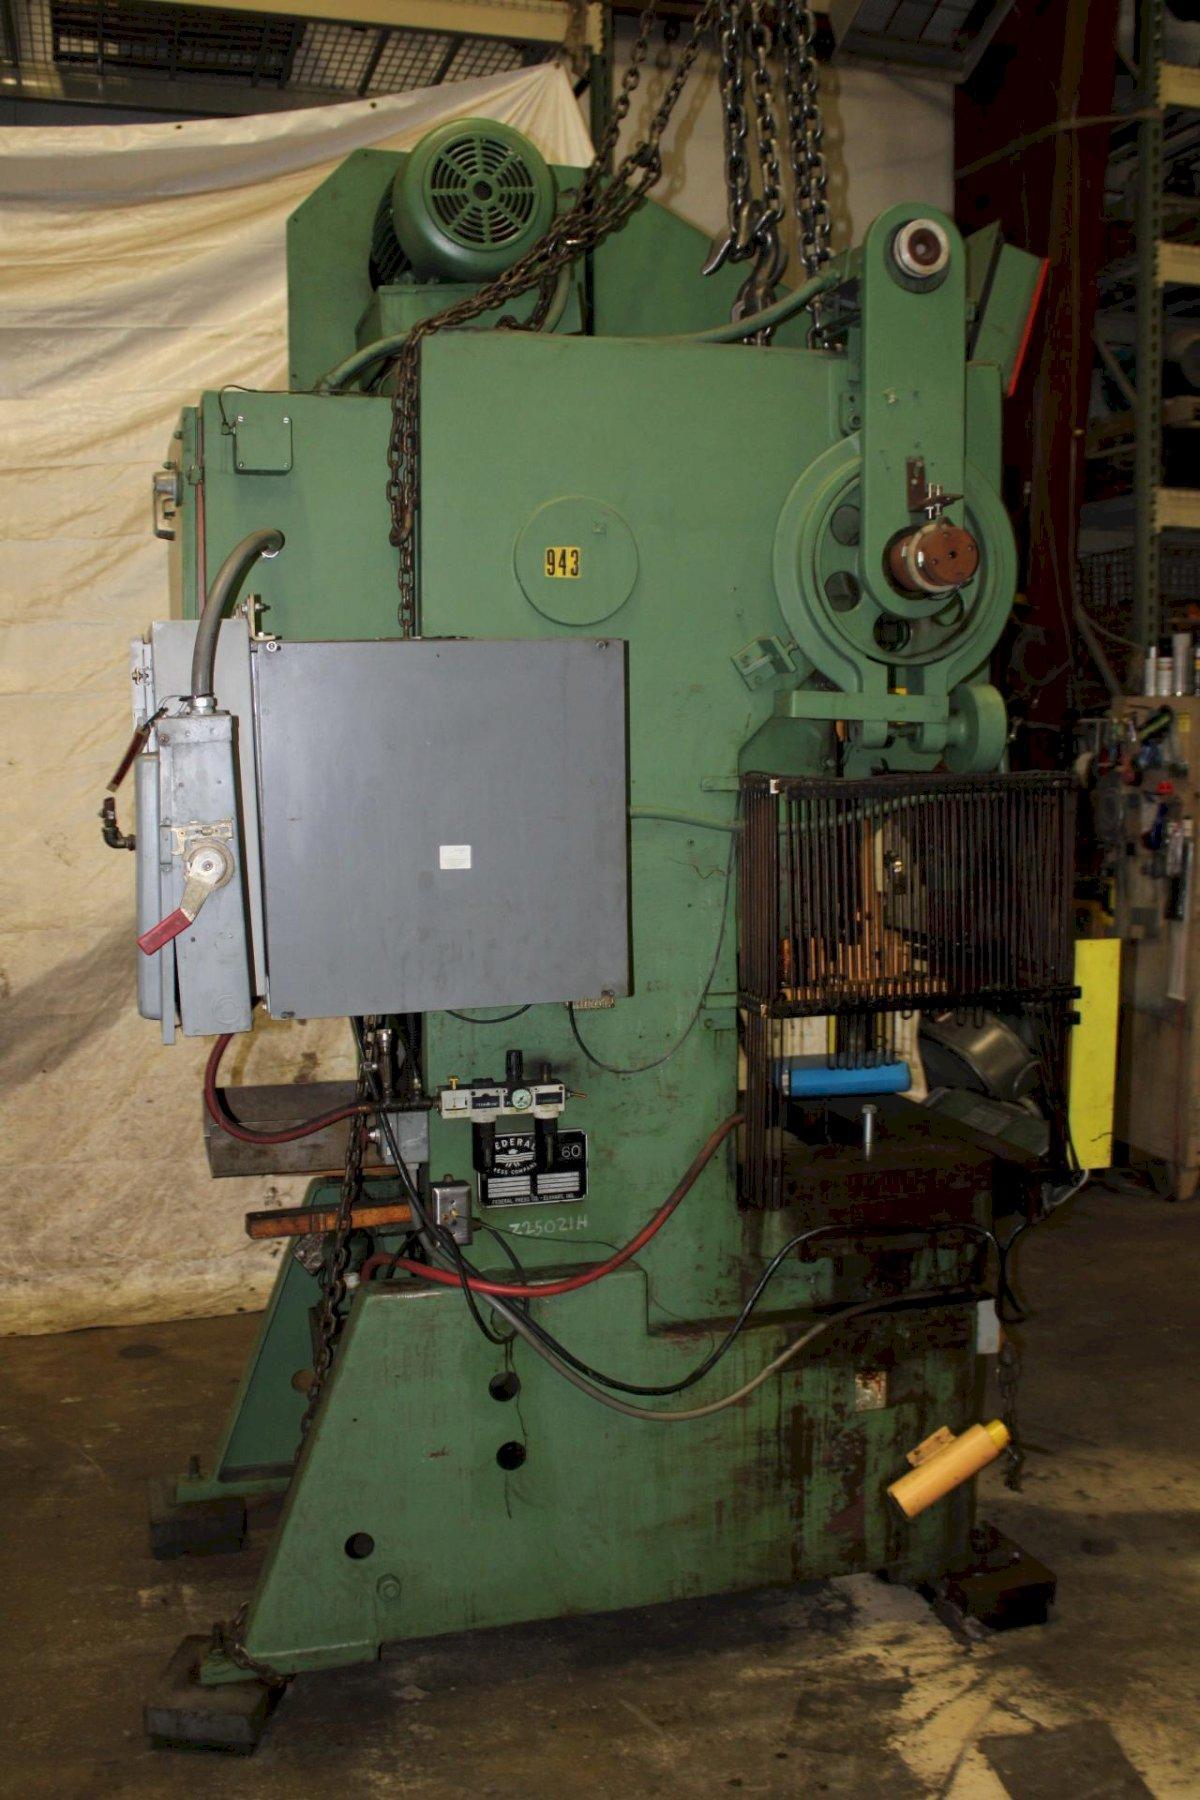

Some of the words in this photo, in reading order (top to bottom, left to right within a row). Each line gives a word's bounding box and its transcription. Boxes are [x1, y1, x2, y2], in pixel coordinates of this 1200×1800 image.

[547, 549, 579, 576] 943
[494, 1137, 536, 1151] EDERAL
[561, 1144, 582, 1158] 60
[511, 1162, 538, 1175] COMPANY
